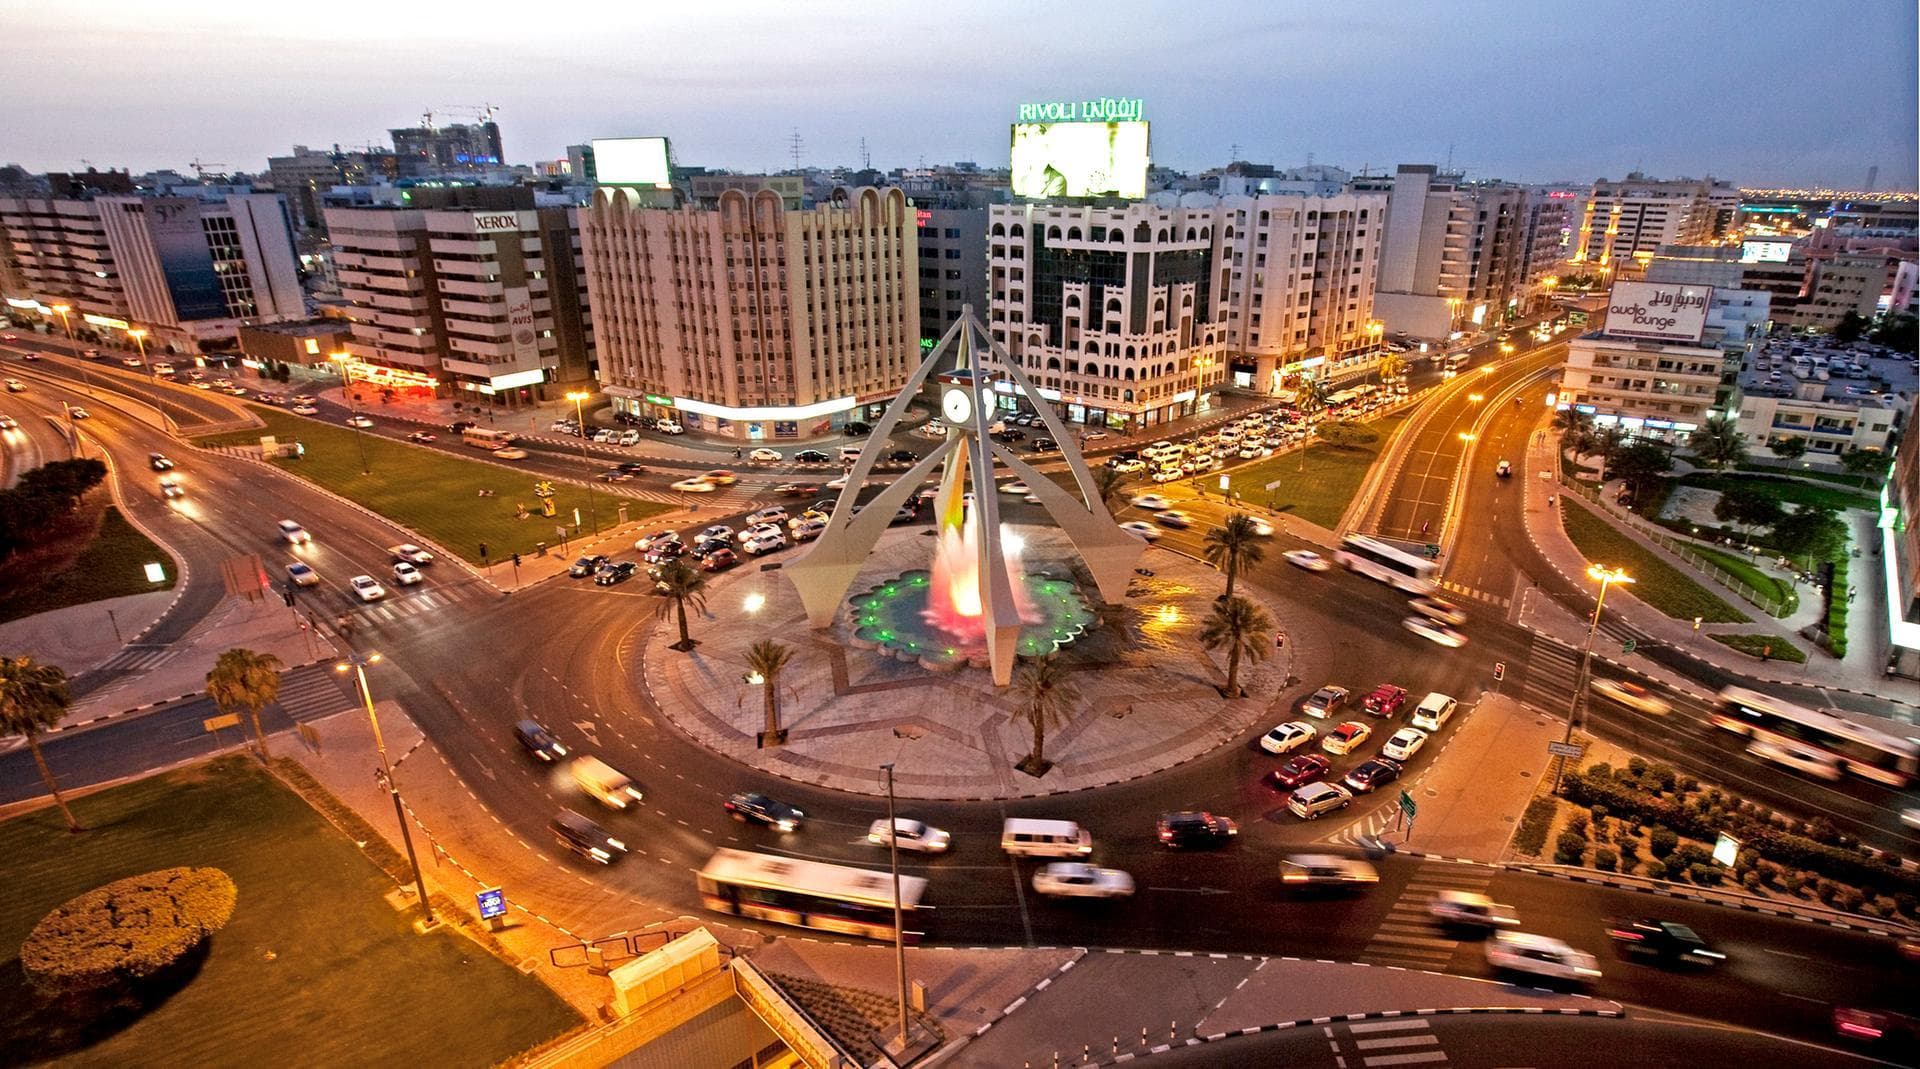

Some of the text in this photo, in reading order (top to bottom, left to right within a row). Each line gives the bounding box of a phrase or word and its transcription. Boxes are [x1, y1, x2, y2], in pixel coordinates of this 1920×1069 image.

[1020, 103, 1076, 120] RIVOLI
[475, 215, 518, 229] XEROX
[1610, 303, 1646, 316] audio
[512, 315, 532, 326] AVIS
[1633, 314, 1676, 330] lounge
